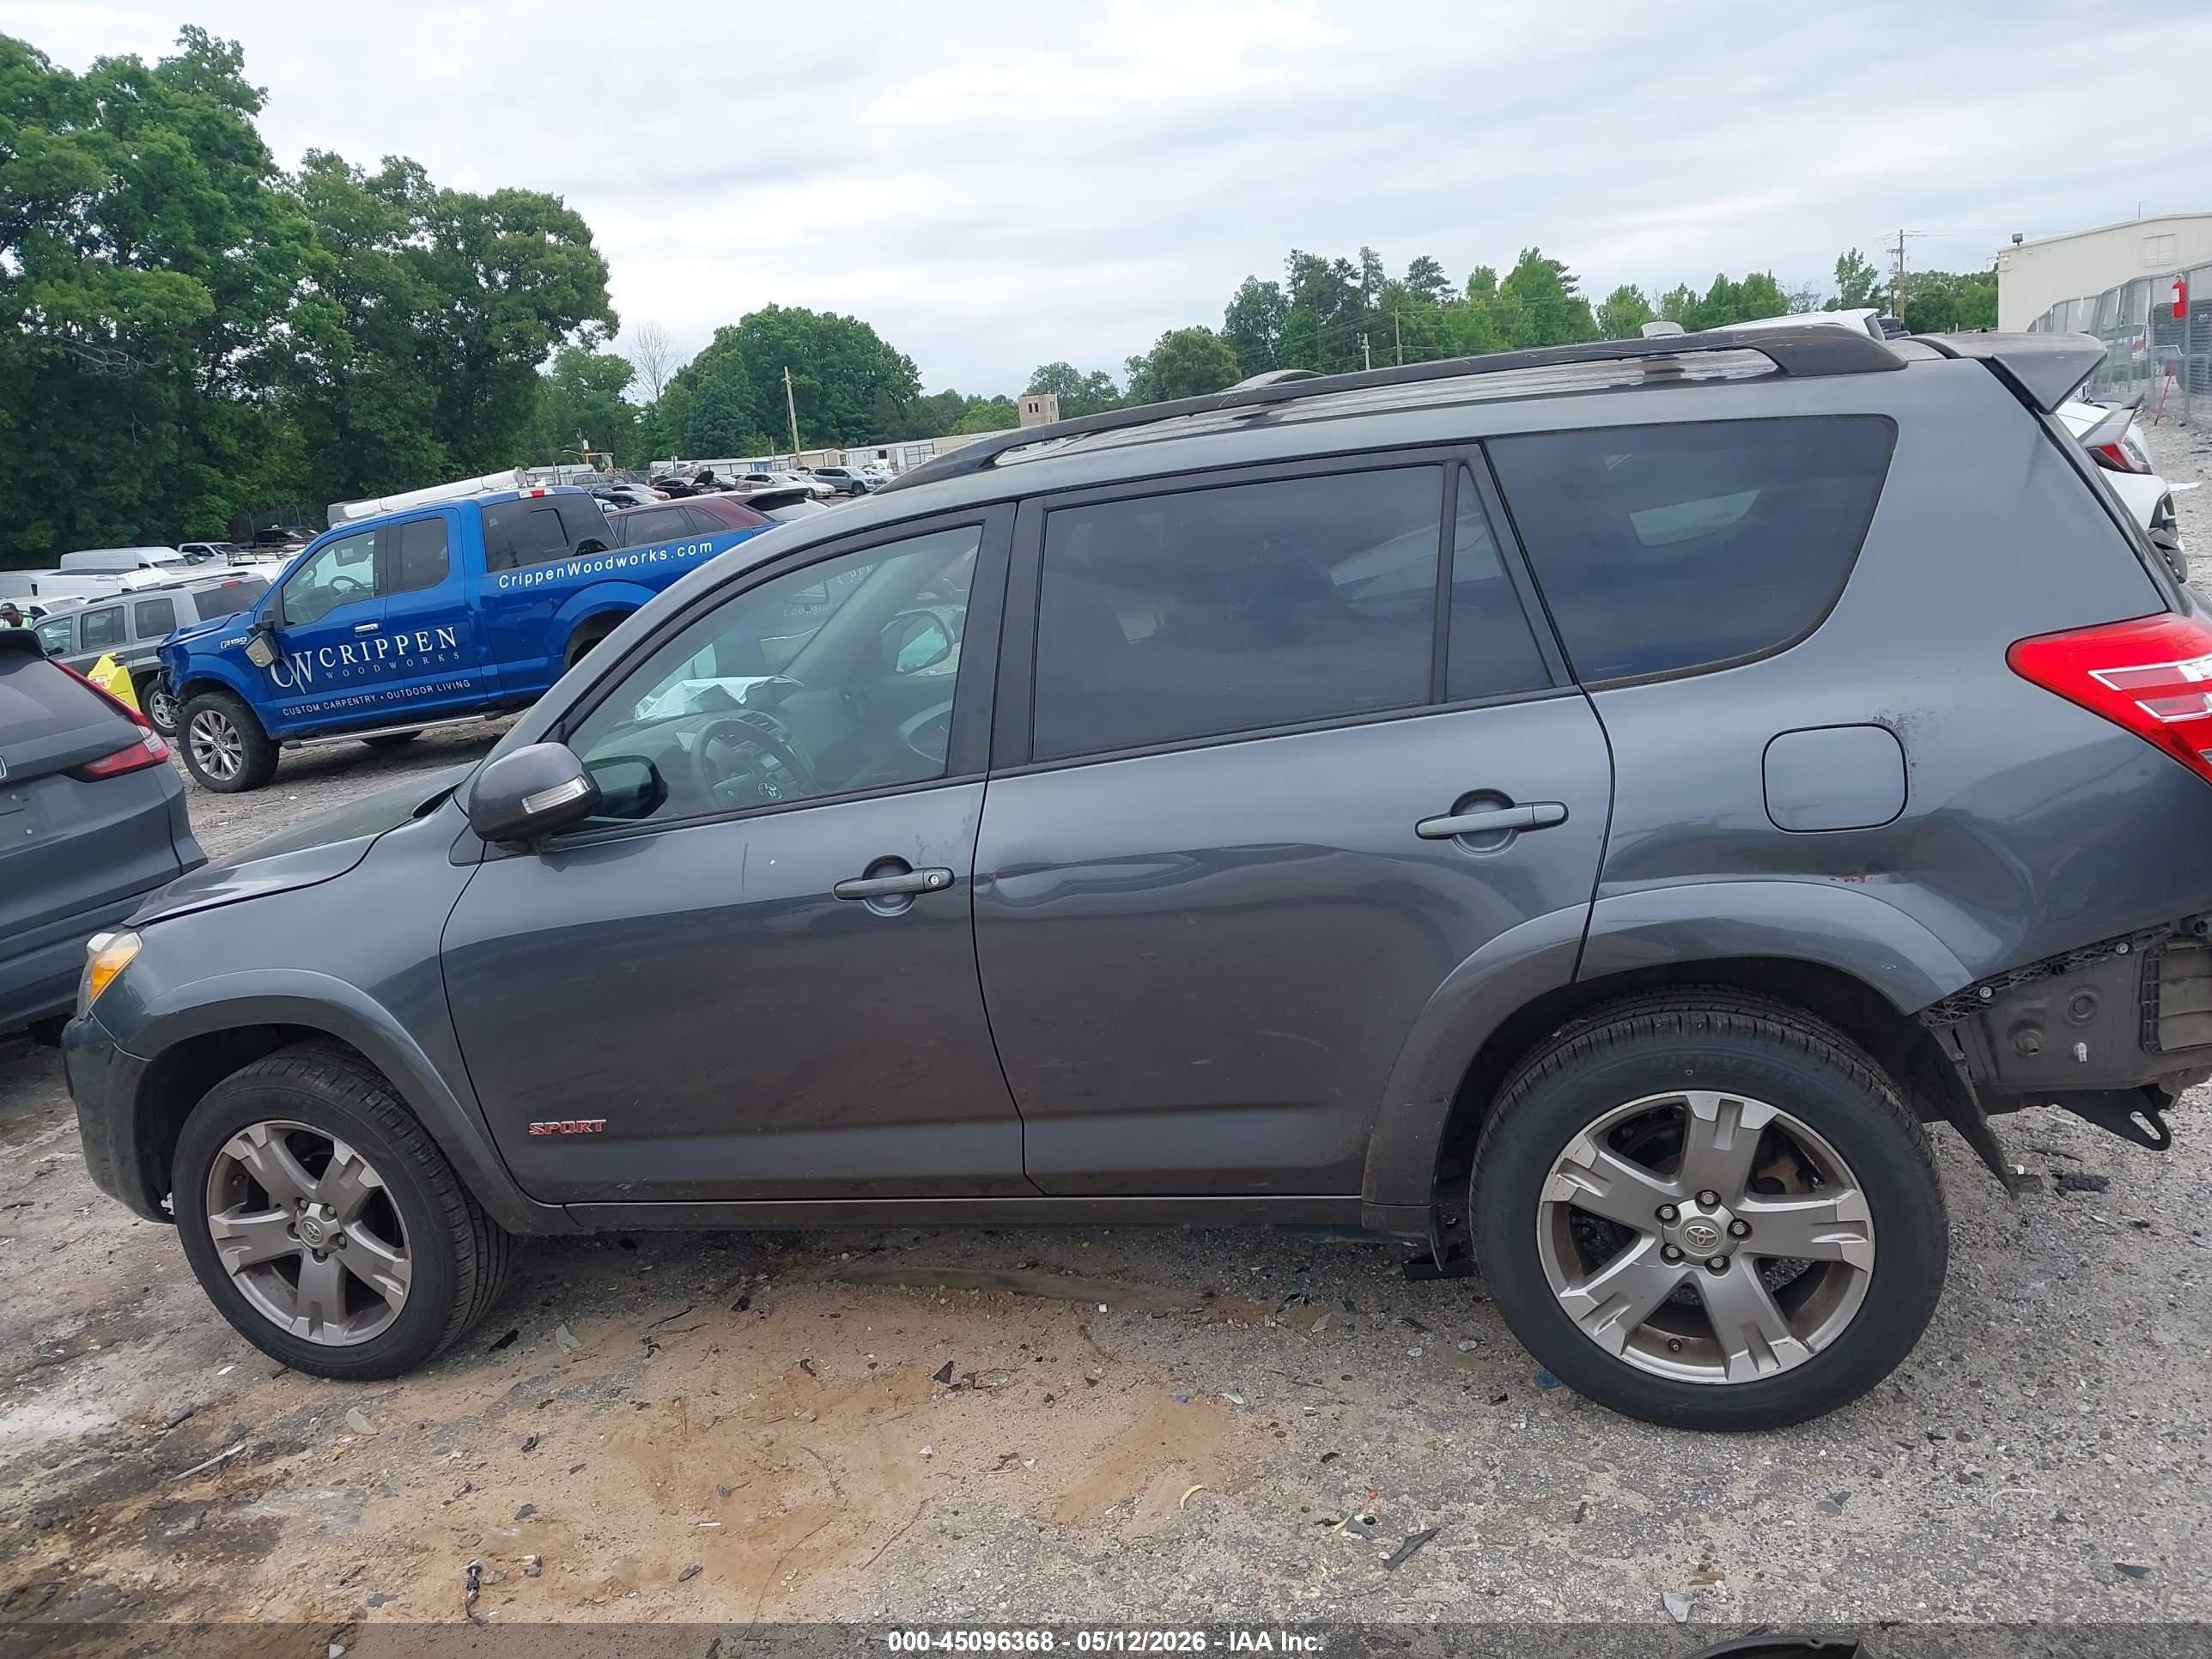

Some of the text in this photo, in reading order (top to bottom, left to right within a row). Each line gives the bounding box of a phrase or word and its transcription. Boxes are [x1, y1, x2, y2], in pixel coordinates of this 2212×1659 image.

[499, 541, 713, 589] CrippenWoodworks.com
[319, 626, 458, 668] CRIPPEN
[325, 651, 459, 680] WOODWORKS
[283, 679, 471, 717] CUSTOM CARPENTRY OUTDOOR LIVING
[528, 1119, 607, 1135] SPORT
